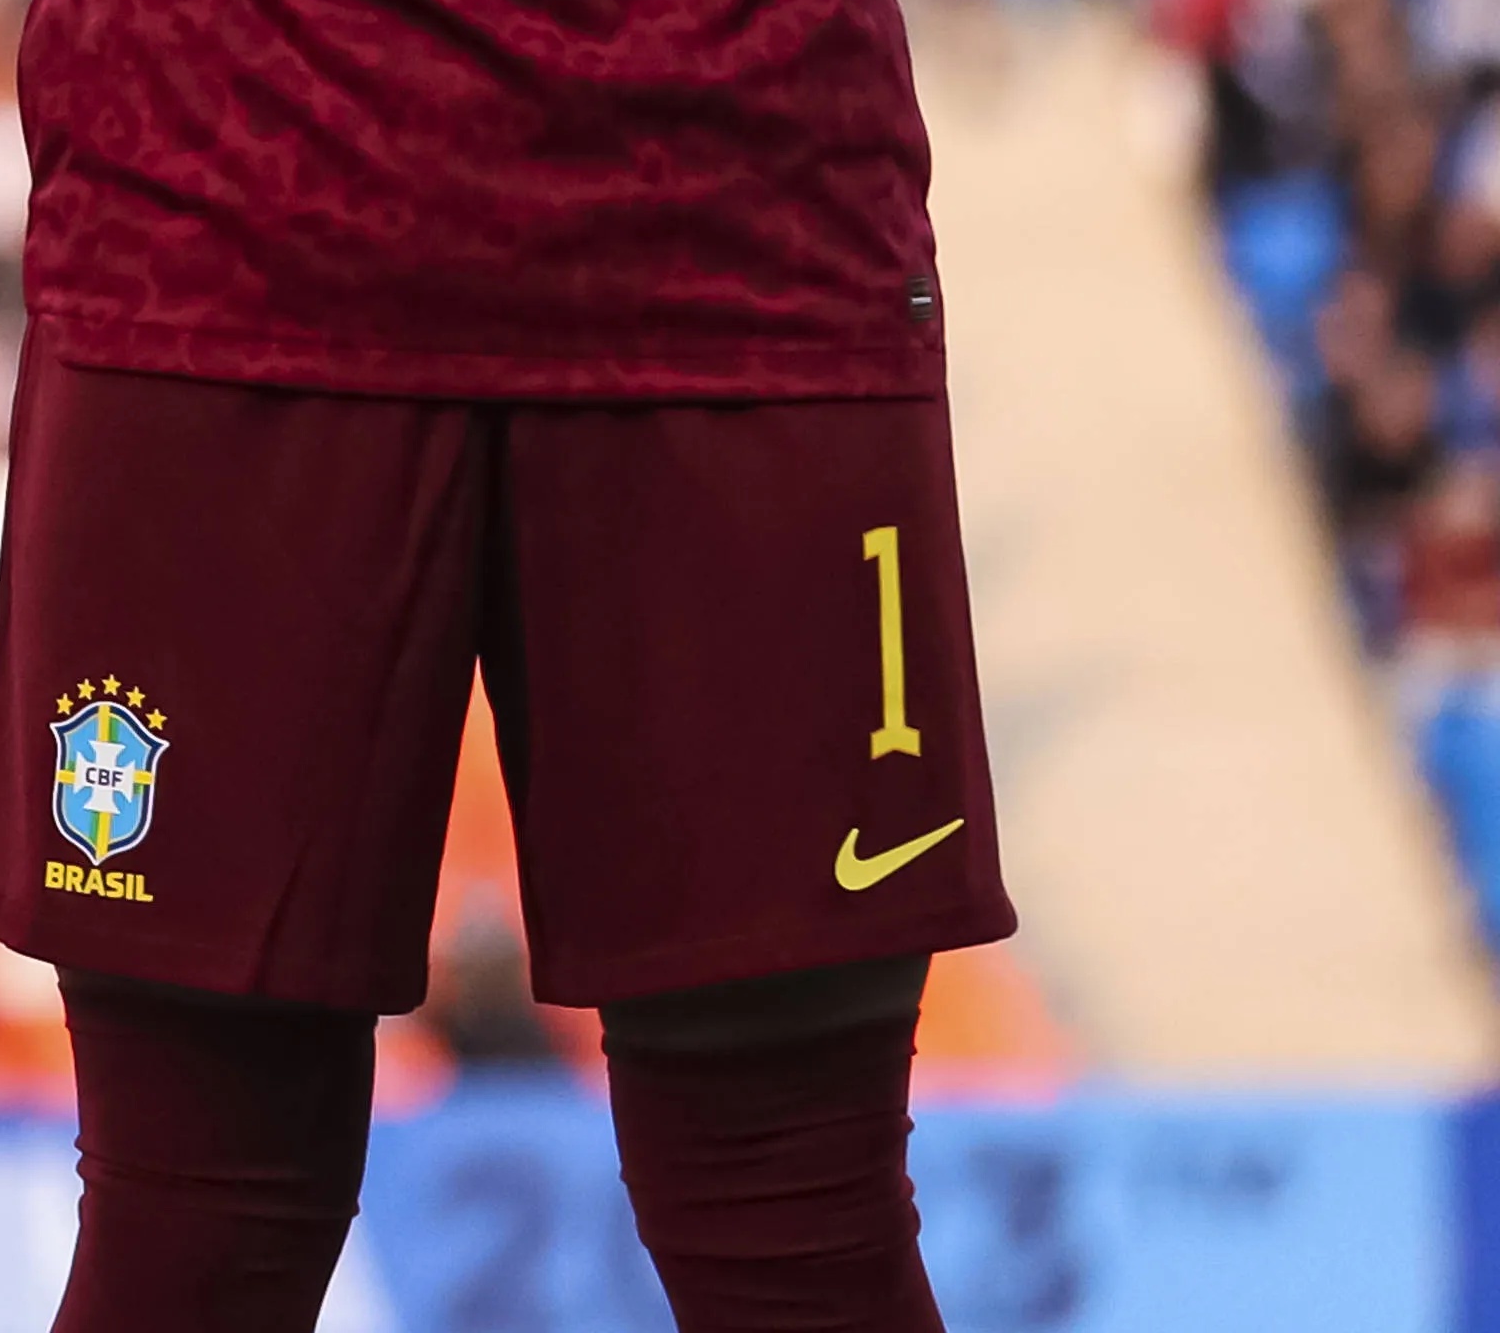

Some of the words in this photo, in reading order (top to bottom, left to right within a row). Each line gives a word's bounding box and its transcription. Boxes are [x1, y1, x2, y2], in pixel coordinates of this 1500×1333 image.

[863, 526, 921, 760] 1
[85, 766, 124, 789] CBF
[45, 860, 155, 903] BRASIL
